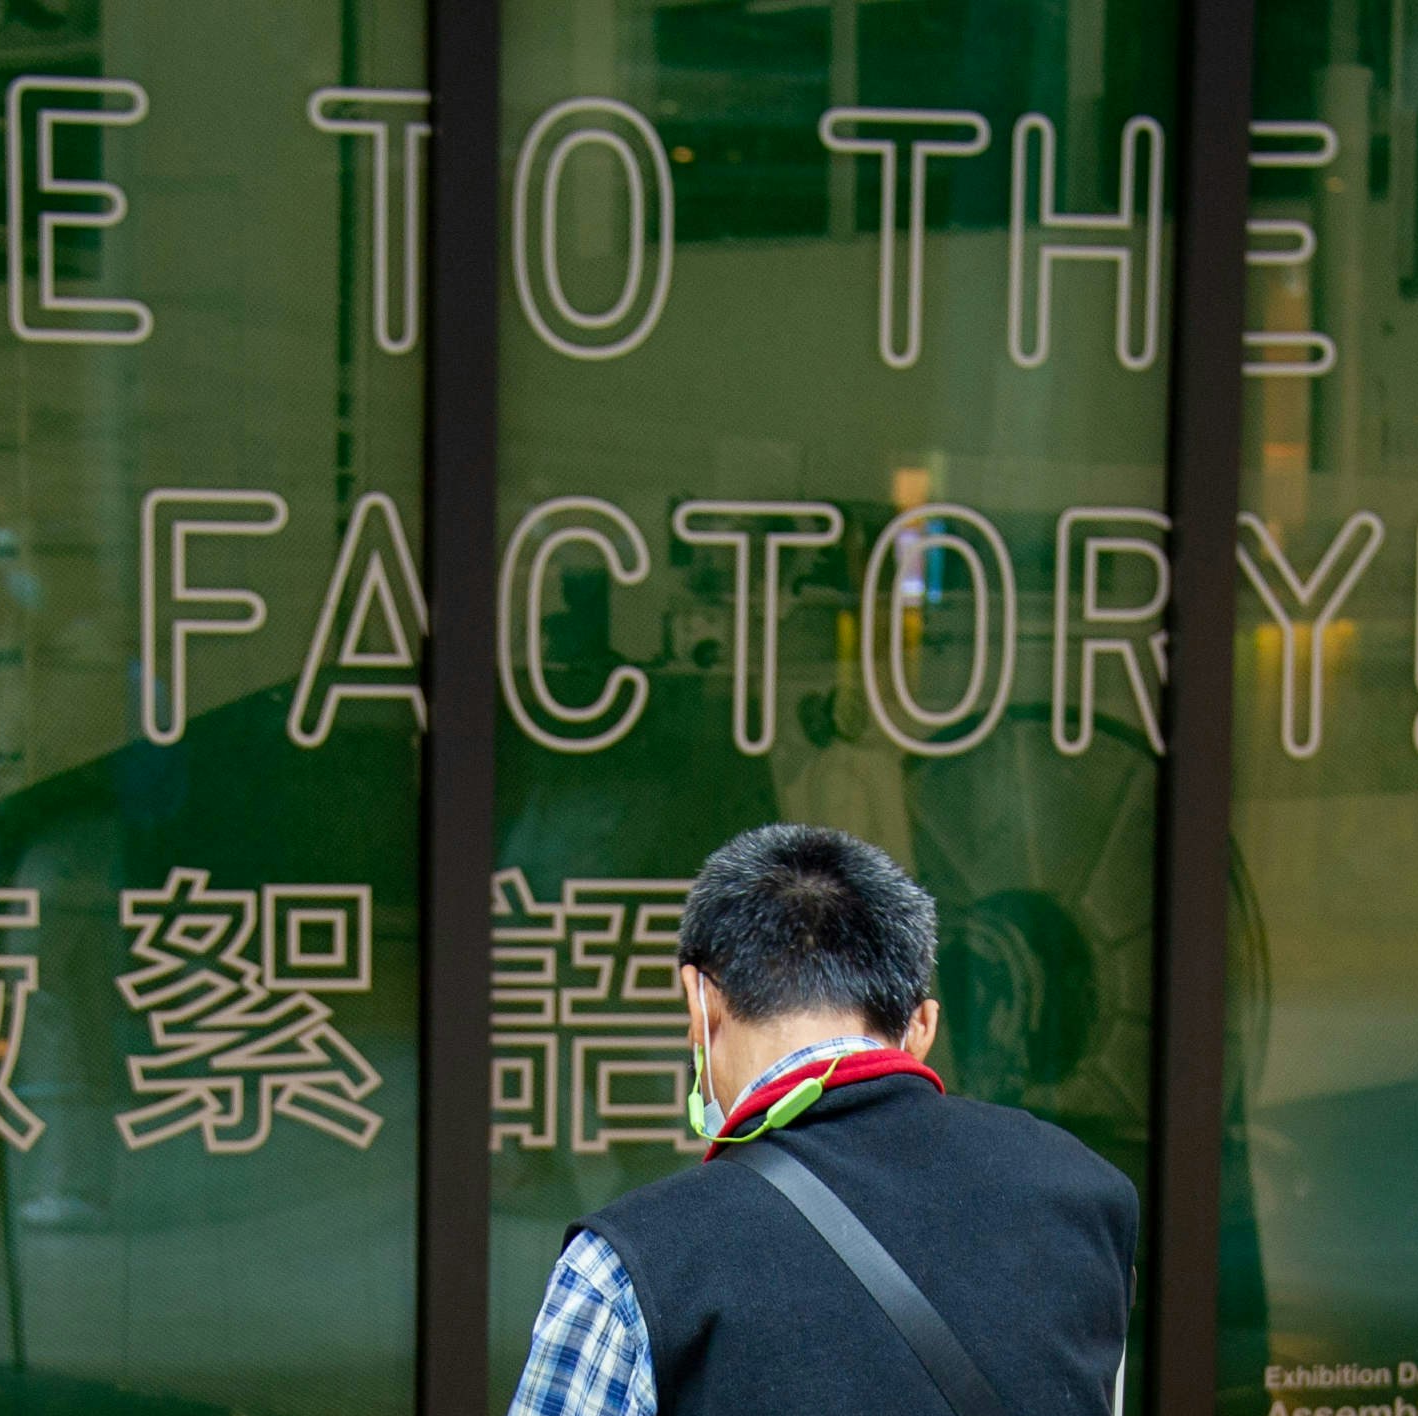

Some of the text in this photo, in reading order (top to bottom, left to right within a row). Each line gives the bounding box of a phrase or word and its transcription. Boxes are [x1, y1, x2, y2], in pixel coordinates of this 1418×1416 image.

[308, 87, 675, 360] TO
[819, 106, 1339, 378] THE
[1264, 1364, 1391, 1390] Exhibition
